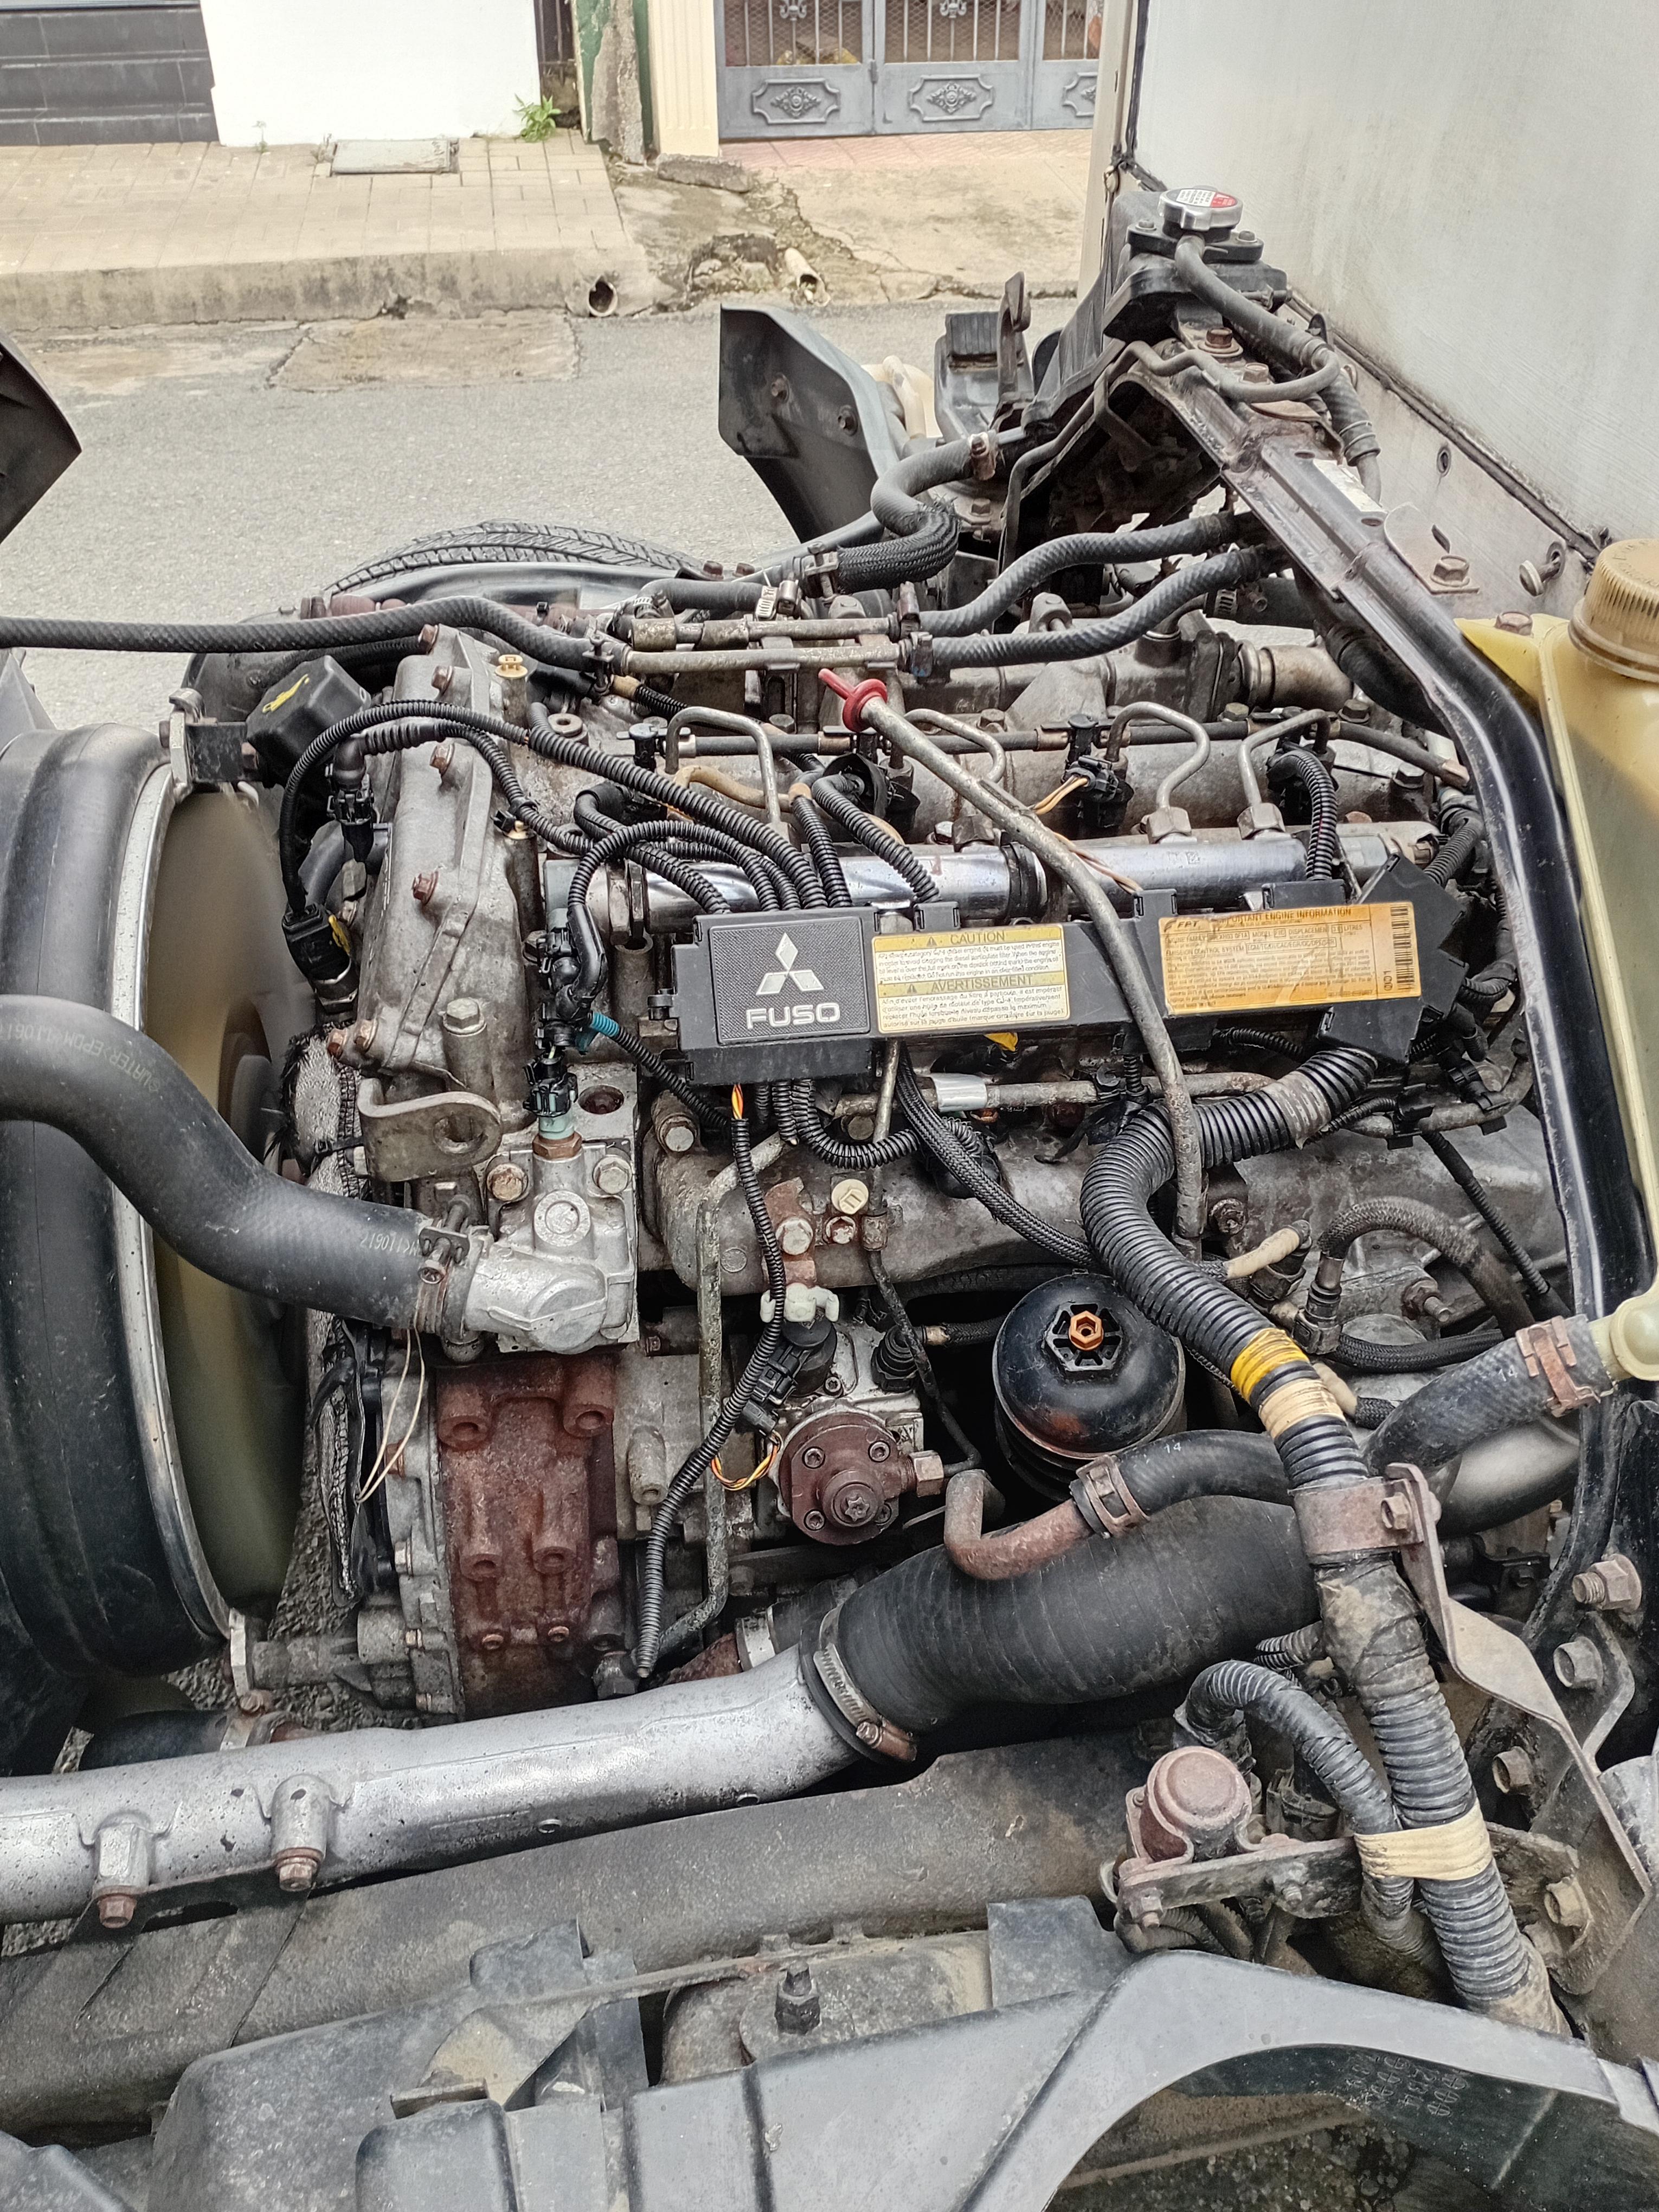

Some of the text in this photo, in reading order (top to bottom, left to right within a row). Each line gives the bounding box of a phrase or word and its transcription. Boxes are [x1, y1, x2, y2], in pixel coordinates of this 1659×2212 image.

[1265, 910, 1295, 921] ENGINE
[1296, 907, 1351, 918] INFORMATION
[1176, 919, 1200, 928] FPT
[950, 931, 1005, 944] CAUTION
[1221, 944, 1244, 953] SYSTEM
[930, 974, 1033, 992] AVERTISSEMENT
[746, 1002, 840, 1029] FUSO
[1498, 1365, 1517, 1381] 14
[1163, 1442, 1181, 1454] 14
